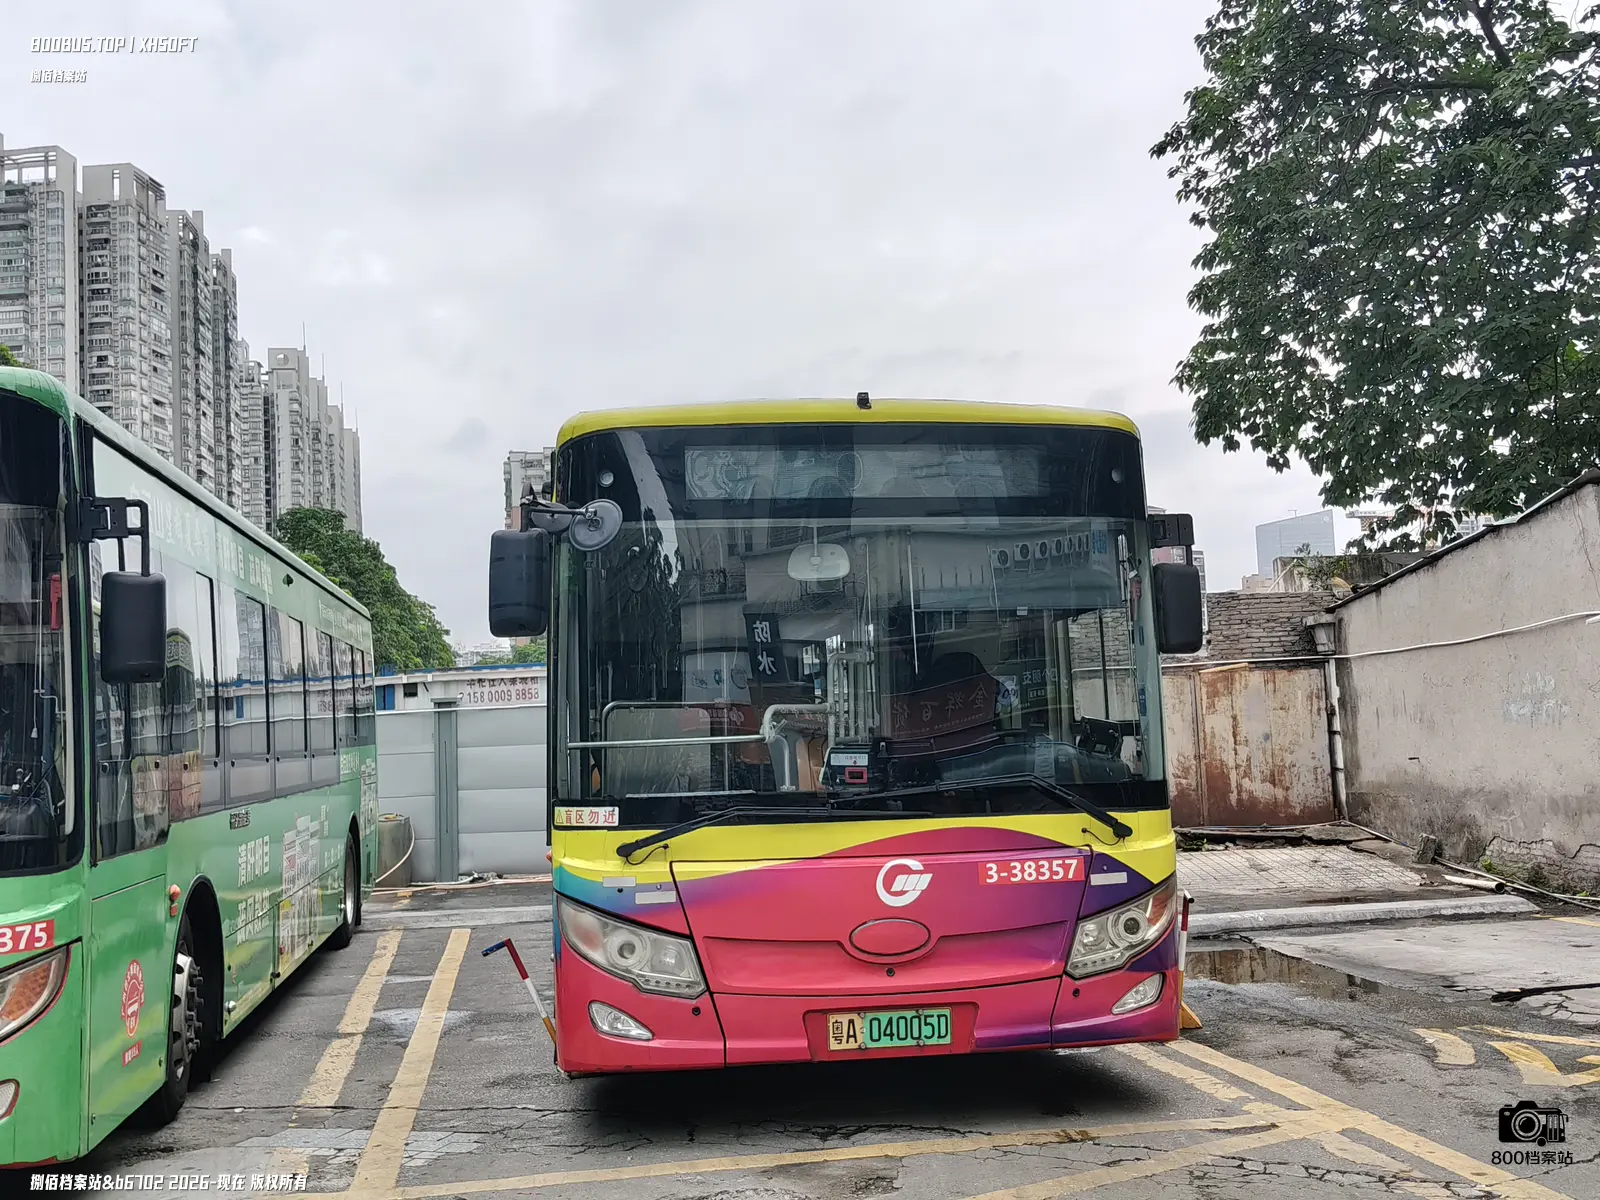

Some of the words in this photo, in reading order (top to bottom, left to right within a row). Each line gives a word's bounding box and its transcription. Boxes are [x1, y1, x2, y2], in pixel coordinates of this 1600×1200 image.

[467, 691, 485, 703] 158
[487, 690, 512, 702] 0009
[565, 808, 616, 824] 盲区勿近
[238, 835, 270, 887] 清肝明目
[985, 858, 1078, 883] 3-38357
[831, 1017, 857, 1046] 粤A
[869, 1013, 949, 1041] 04005D
